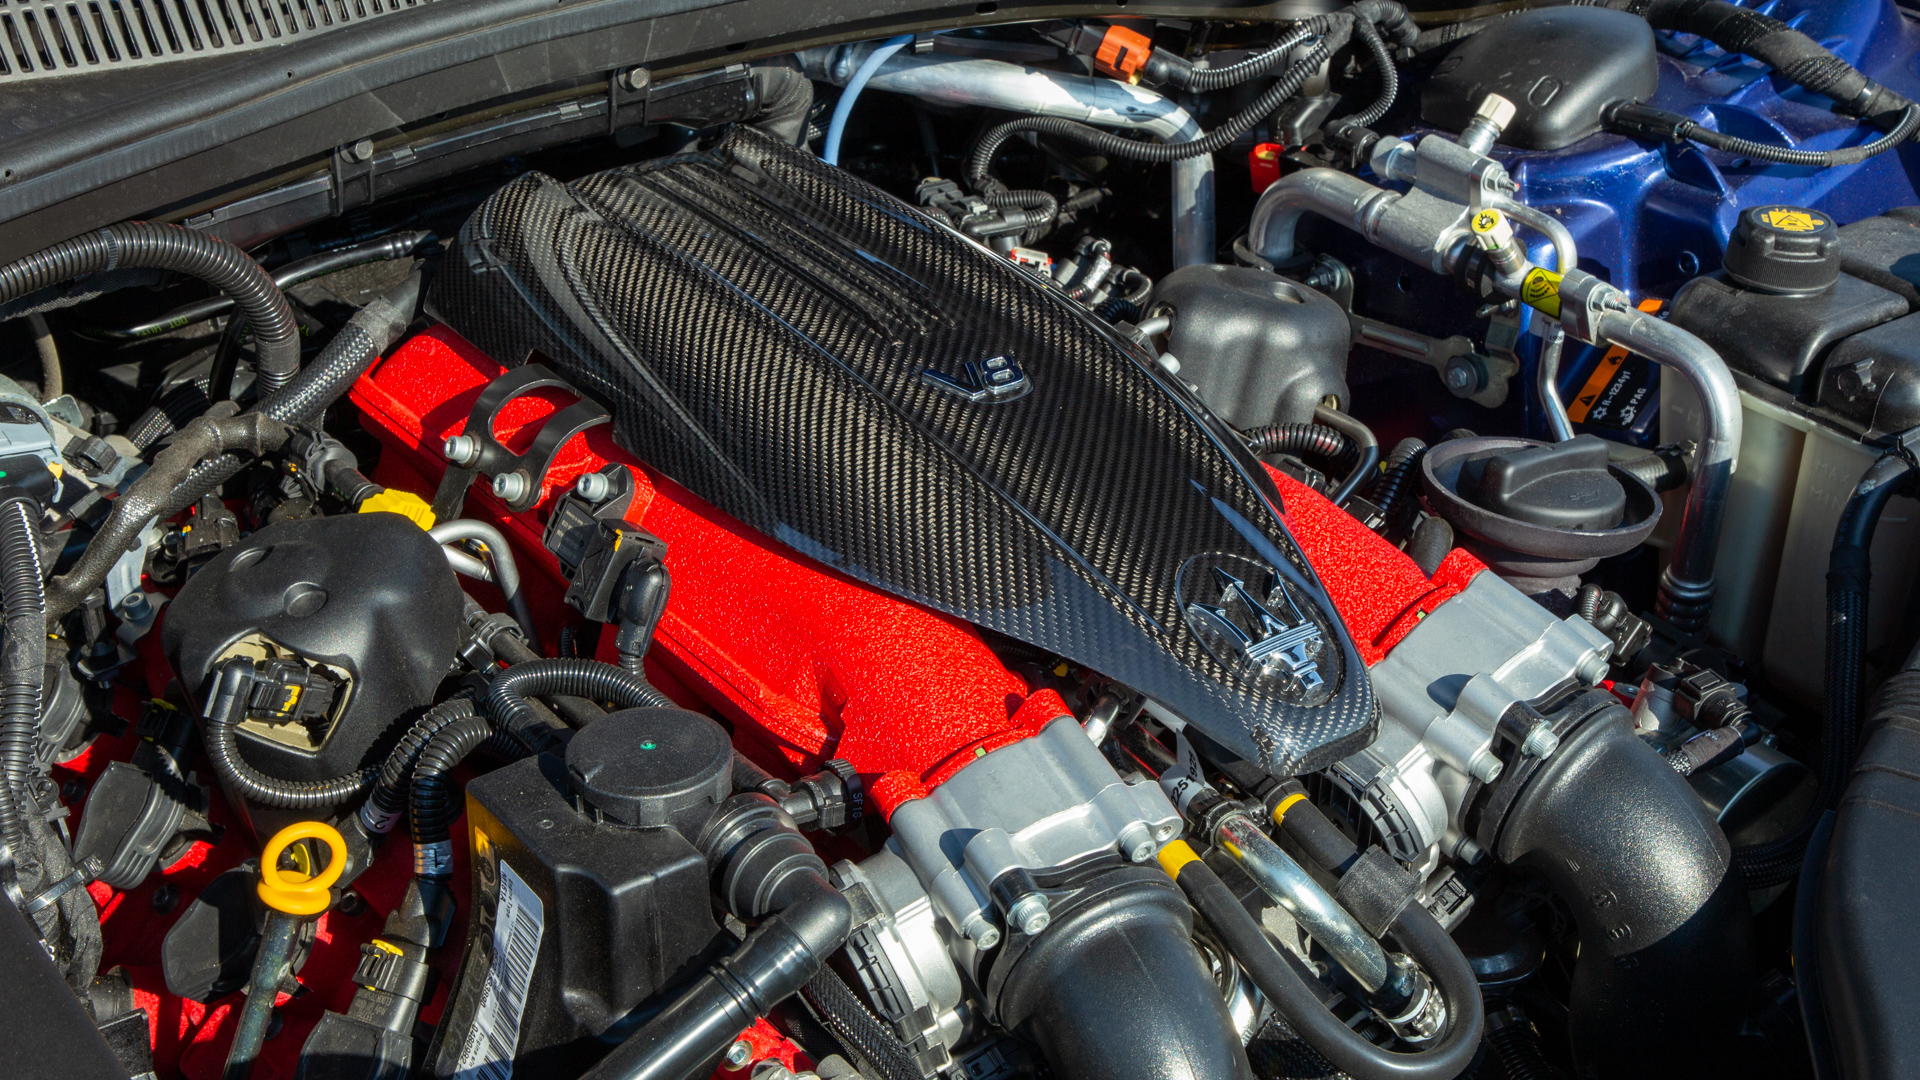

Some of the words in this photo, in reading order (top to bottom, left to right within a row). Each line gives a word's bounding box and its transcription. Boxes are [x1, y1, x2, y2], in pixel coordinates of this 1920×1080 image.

[921, 354, 1028, 402] V8
[1629, 387, 1647, 406] PAG
[474, 1032, 485, 1056] Engine
